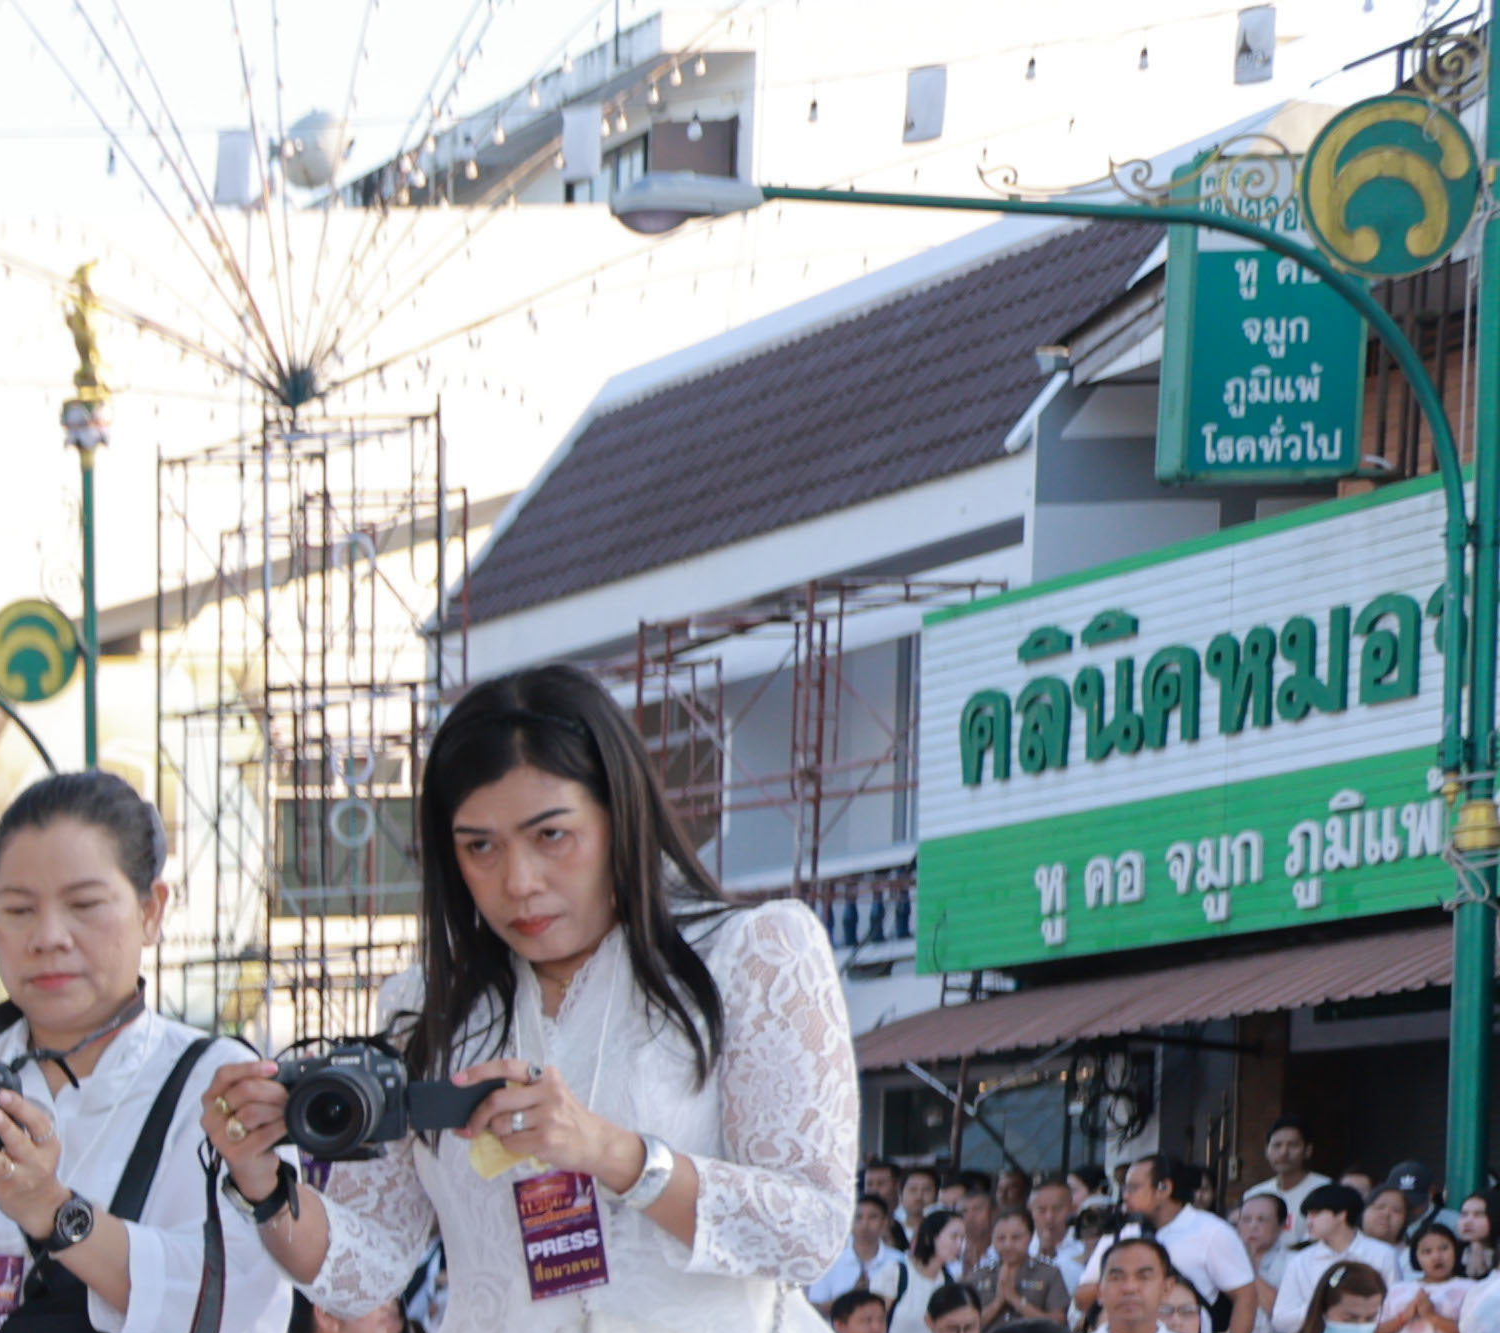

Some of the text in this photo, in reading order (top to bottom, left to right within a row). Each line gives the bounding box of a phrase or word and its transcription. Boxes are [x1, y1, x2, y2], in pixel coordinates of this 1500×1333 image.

[1234, 257, 1258, 300] หู
[1242, 316, 1310, 358] จมูก
[1223, 362, 1324, 418] ภูมิแพ้
[1202, 415, 1343, 464] โรคทั่วไป
[1034, 766, 1445, 946] หู คอ จมูก ภูมิแพ้
[527, 1228, 599, 1262] PRESS
